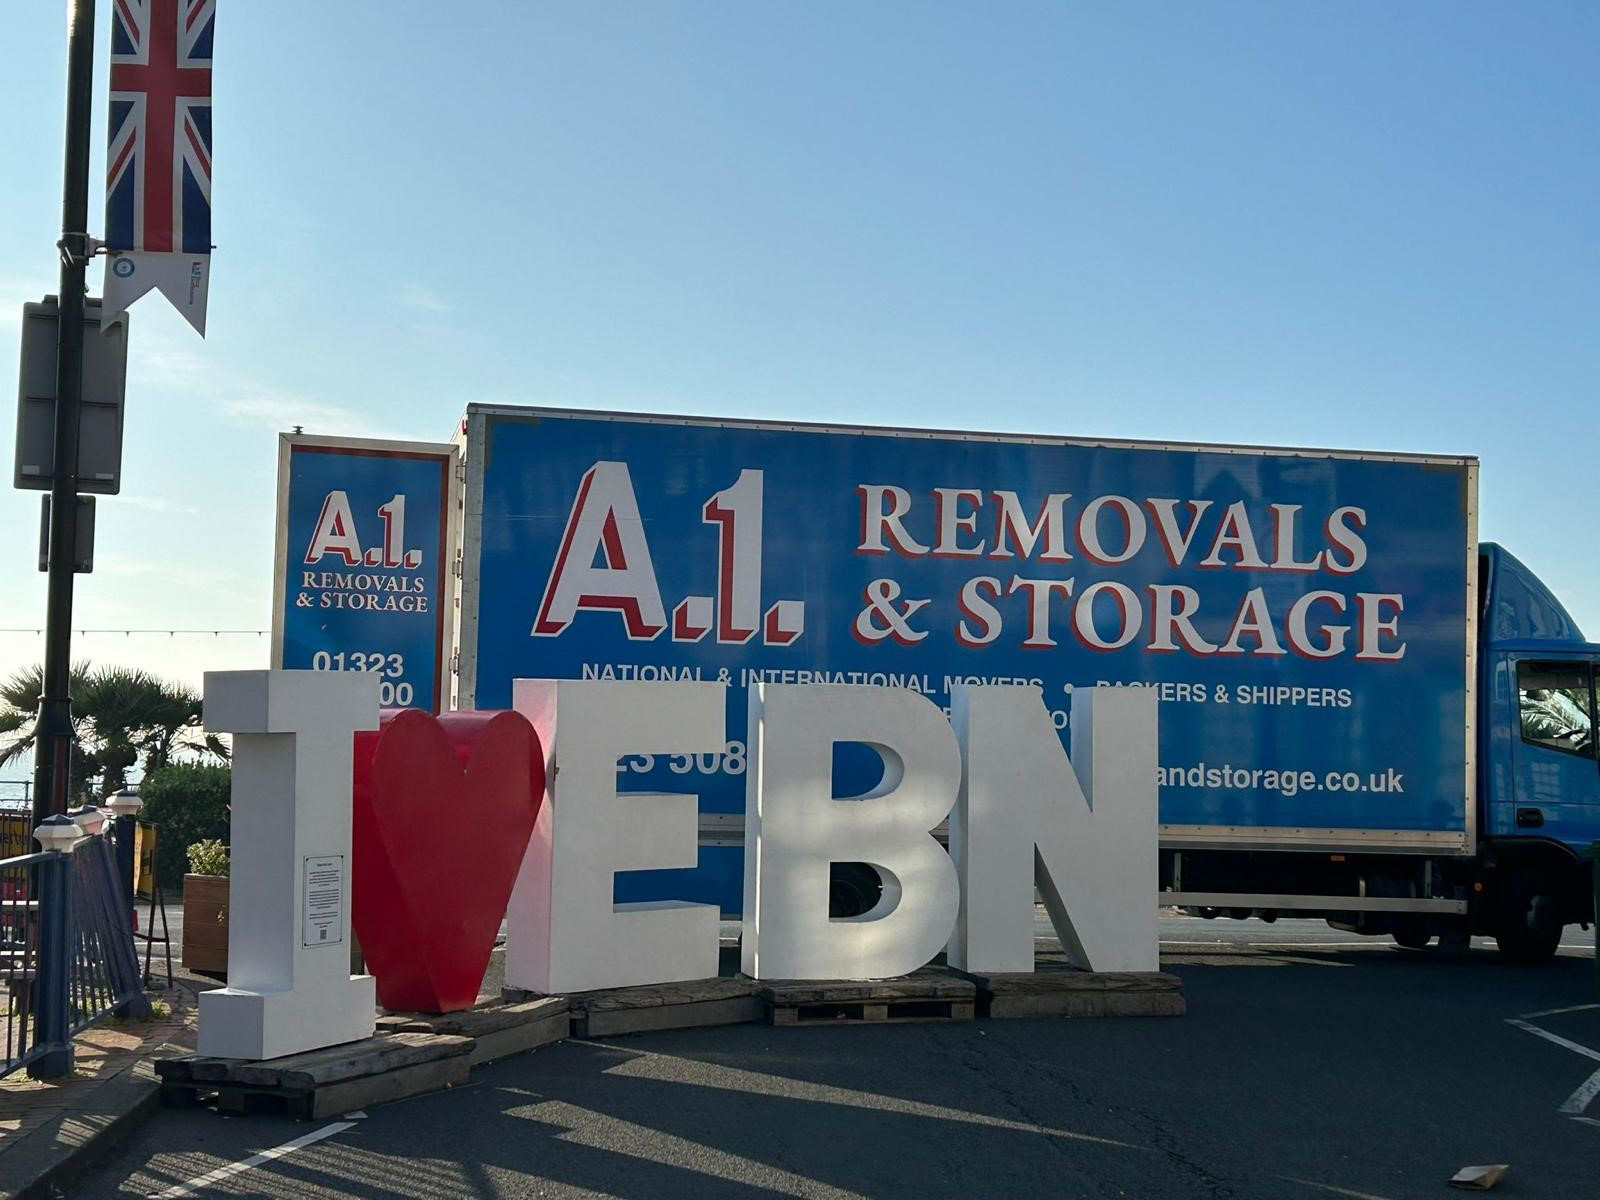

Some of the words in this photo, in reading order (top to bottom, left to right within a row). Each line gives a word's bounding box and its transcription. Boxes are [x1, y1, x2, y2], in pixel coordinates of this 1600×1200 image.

[855, 483, 1368, 576] REMOVALS
[302, 571, 425, 593] REMOVALS
[296, 592, 314, 608] &
[320, 592, 428, 613] STORAGE
[852, 578, 931, 645] &
[956, 574, 1407, 662] STORAGE
[312, 651, 404, 677] 01323
[717, 667, 733, 687] &
[741, 668, 936, 694] INTERNATIONAL
[1214, 684, 1230, 704] &
[1236, 685, 1352, 708] SHIPPERS
[505, 678, 1160, 994] EBN
